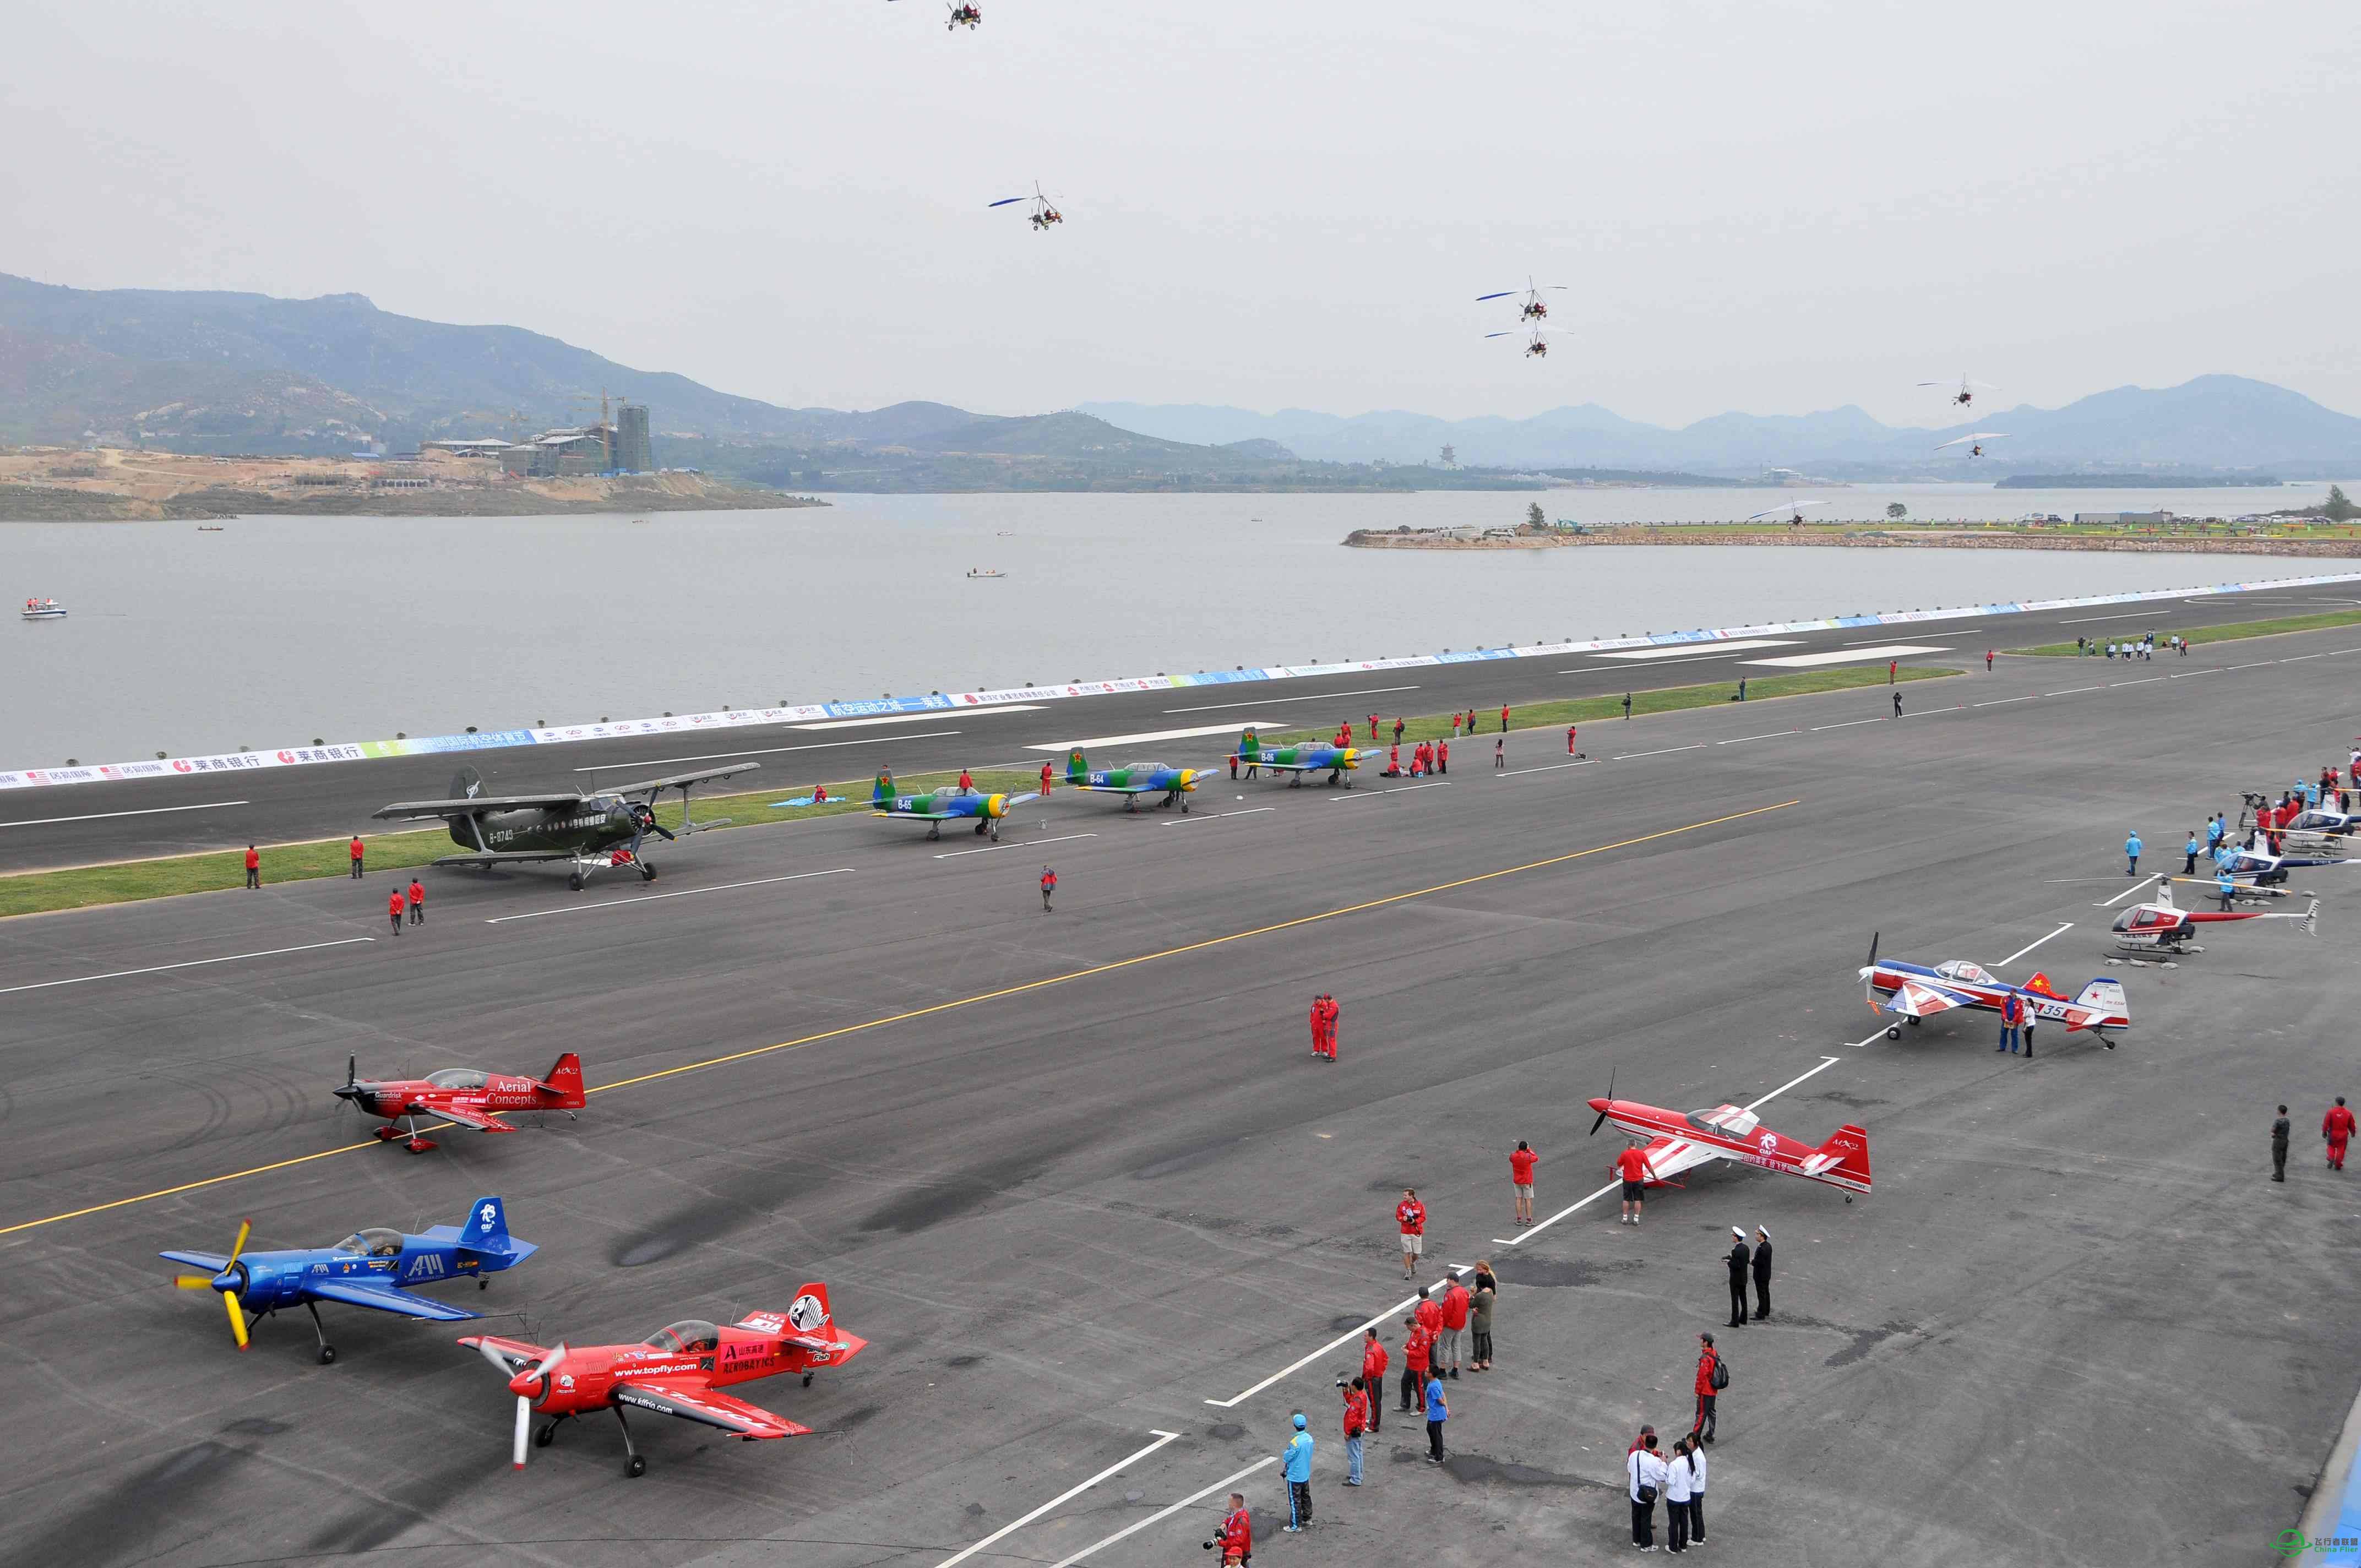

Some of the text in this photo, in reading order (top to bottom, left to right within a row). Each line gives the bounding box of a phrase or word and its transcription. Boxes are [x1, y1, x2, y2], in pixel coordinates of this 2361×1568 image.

[296, 746, 359, 763] 莱商银行
[1261, 753, 1274, 761] B-06
[193, 755, 260, 771] 莱商银行
[1090, 774, 1104, 783] B-64
[898, 799, 912, 810] B-65
[497, 1080, 531, 1092] Aerial
[487, 1092, 537, 1106] Concepts
[739, 1344, 764, 1355] 山东高速
[813, 1353, 830, 1362] Fish
[614, 1364, 697, 1377] www.topfly.com
[723, 1357, 775, 1374] AEROBATICS
